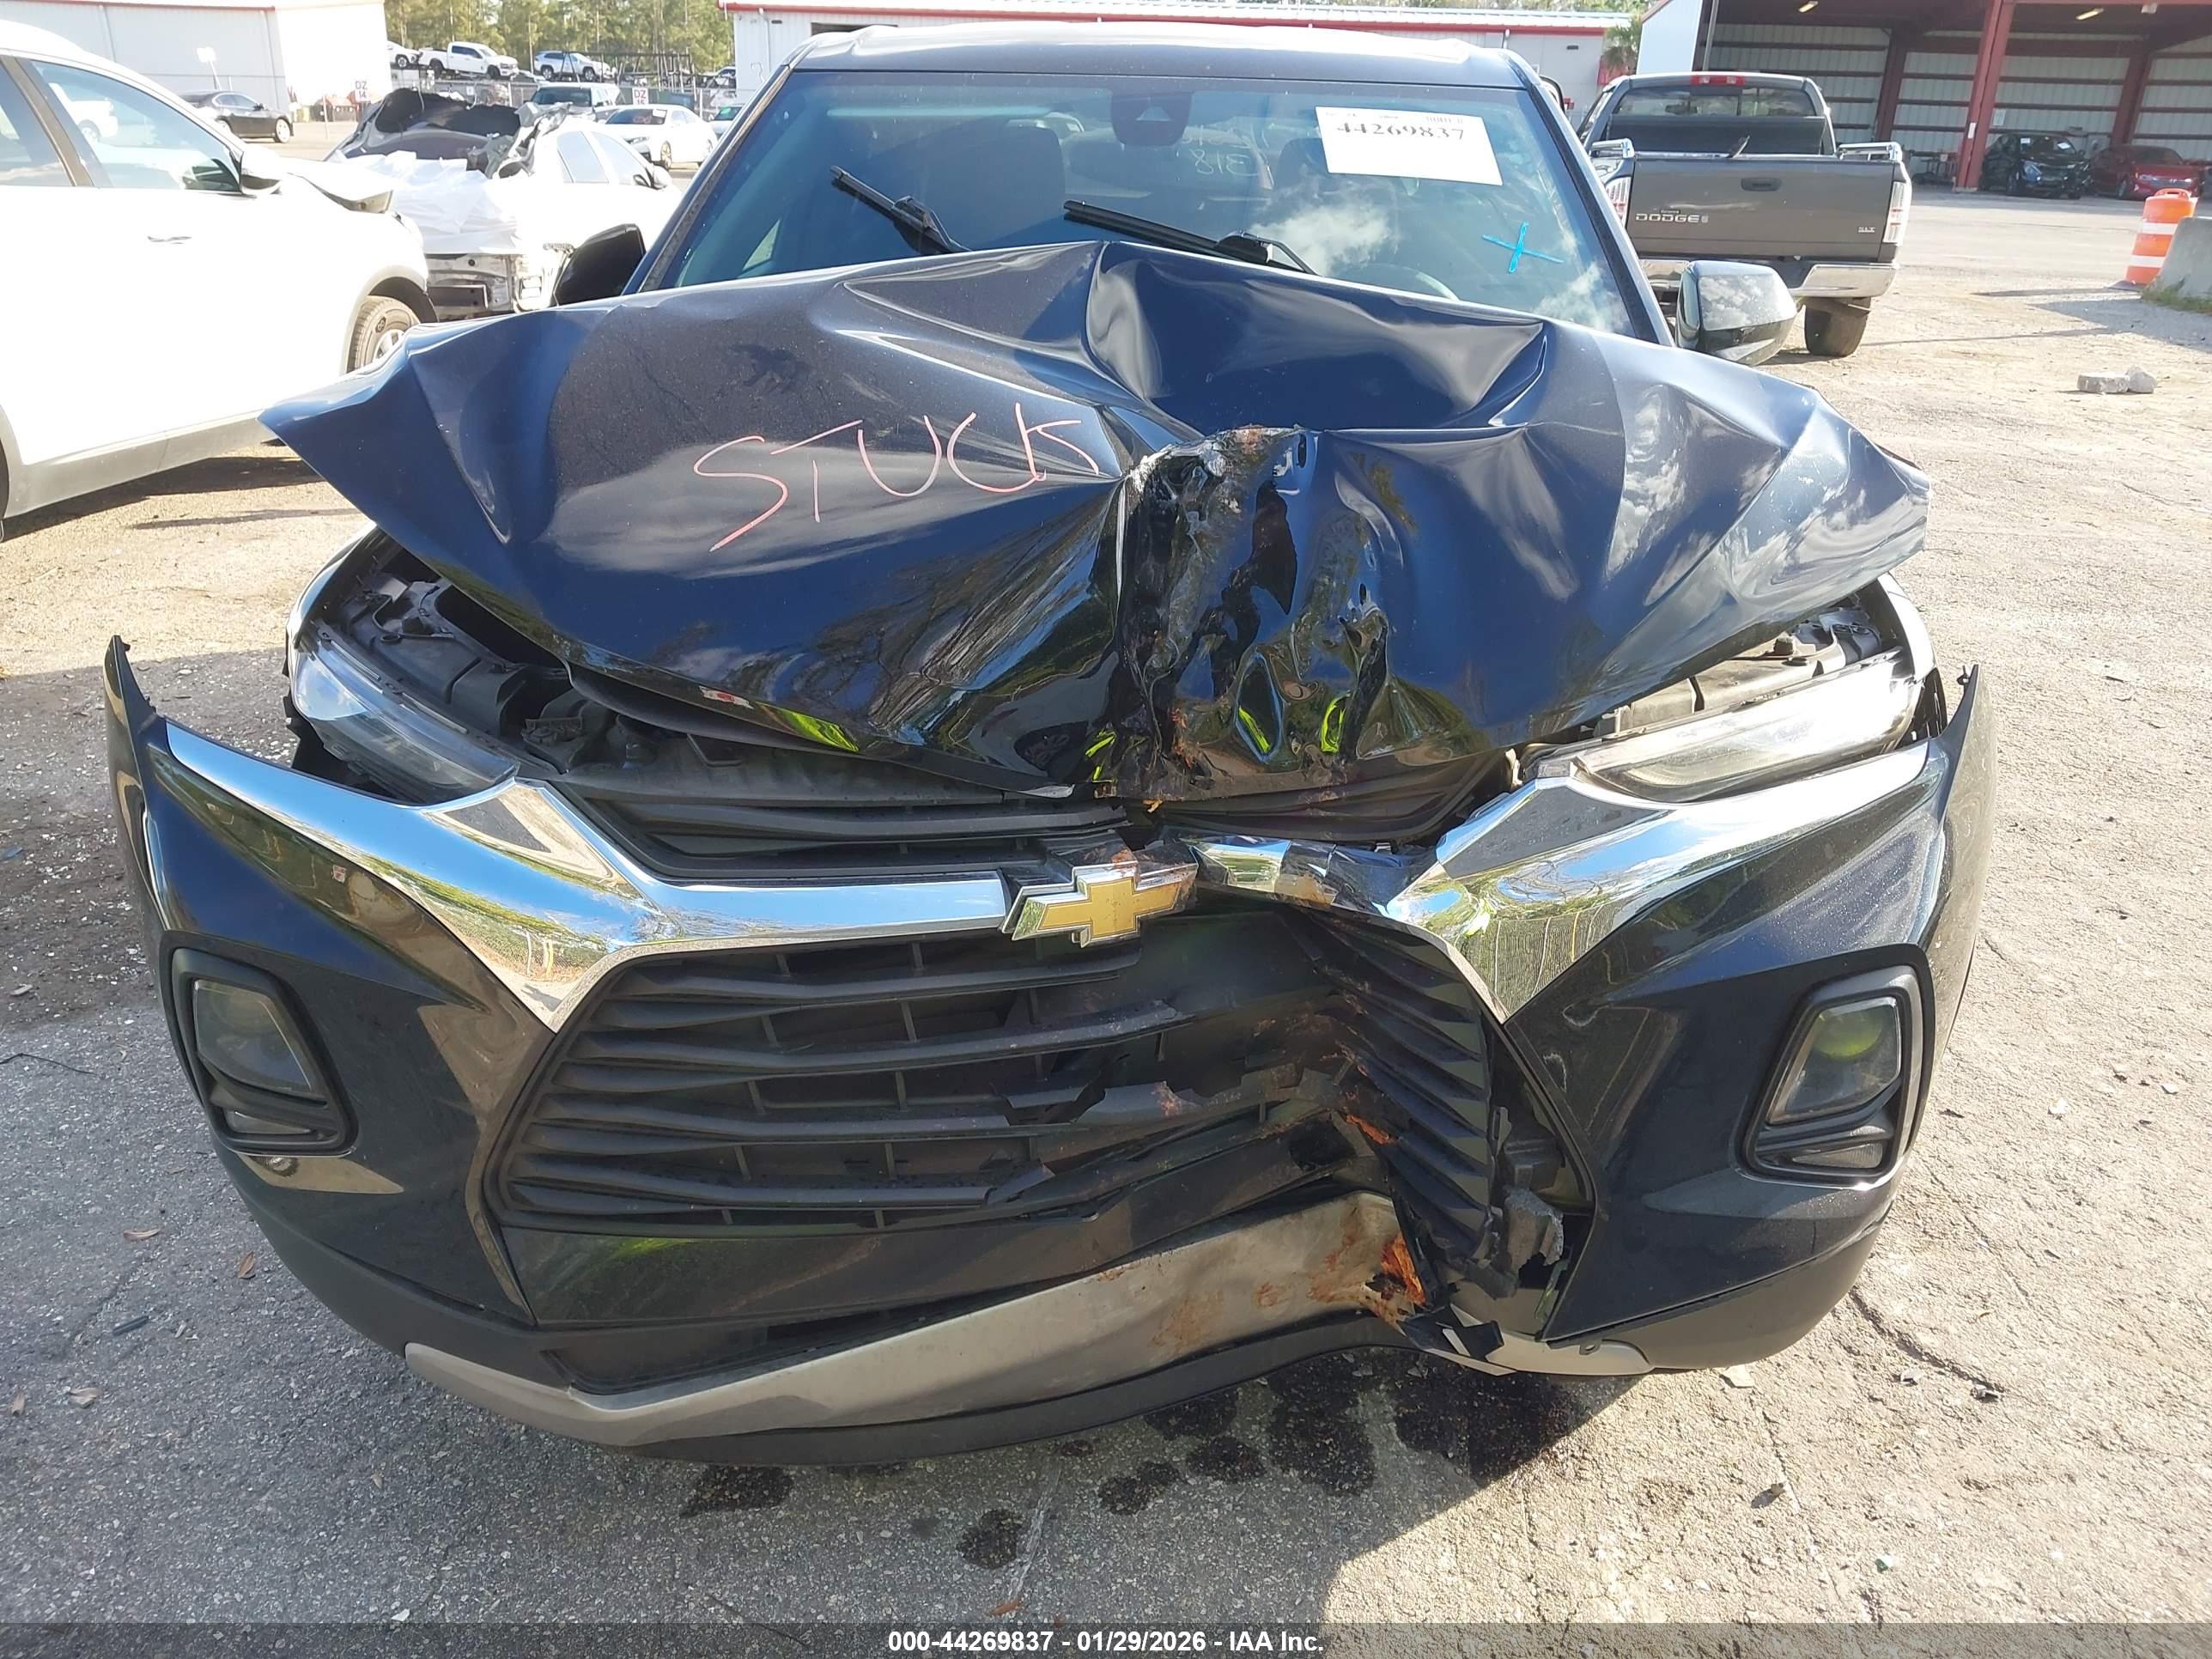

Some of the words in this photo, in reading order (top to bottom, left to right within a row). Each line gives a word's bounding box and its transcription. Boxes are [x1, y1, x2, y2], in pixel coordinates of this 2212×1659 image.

[355, 81, 368, 89] DZ
[634, 89, 647, 99] DZ
[1336, 122, 1464, 140] 44269837
[1635, 213, 1700, 223] DODGE
[692, 402, 1100, 552] STUCK
